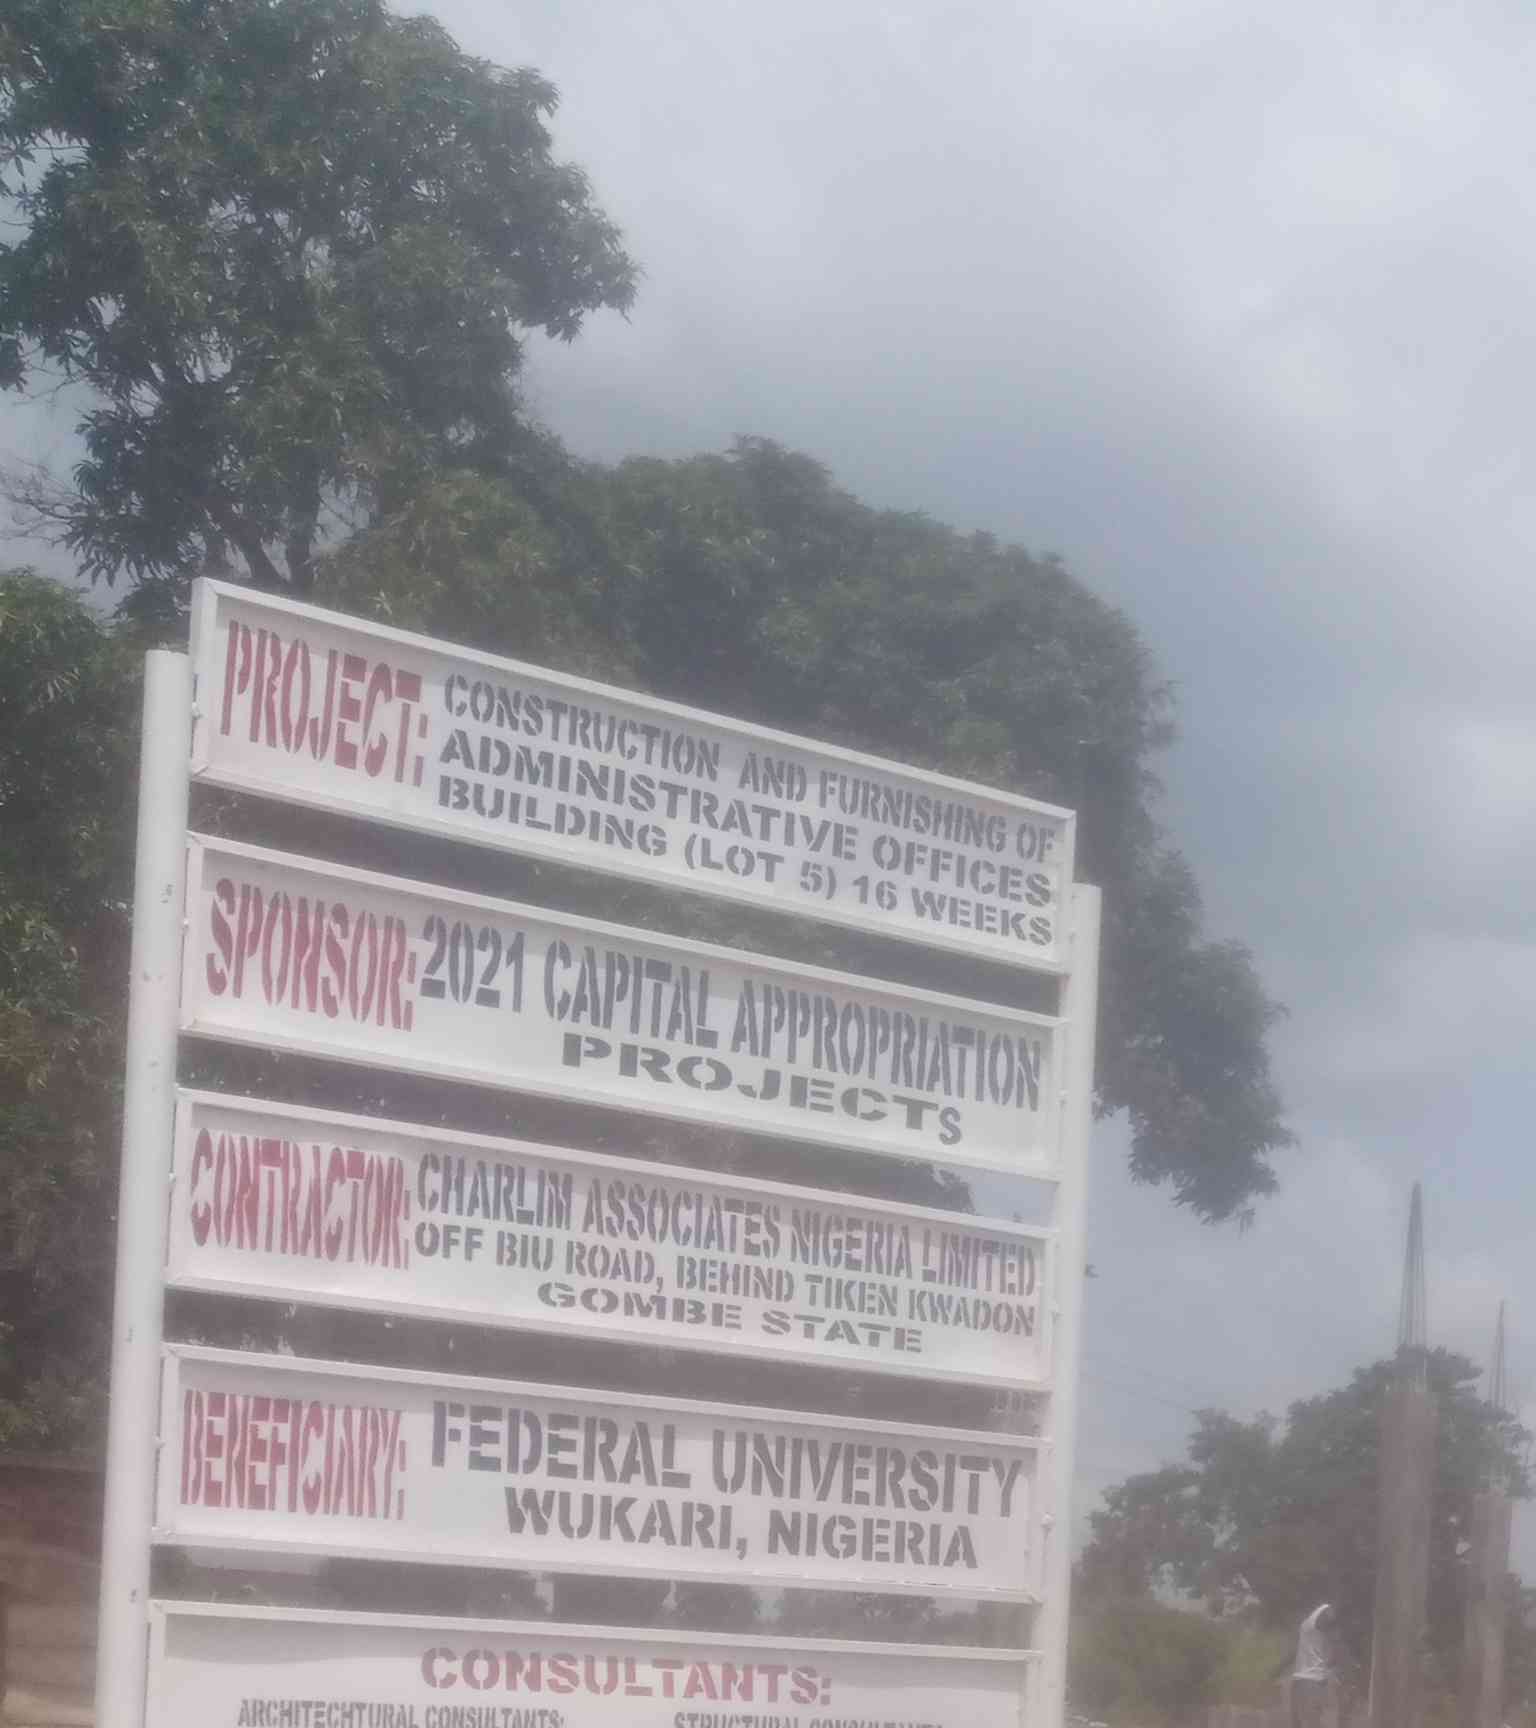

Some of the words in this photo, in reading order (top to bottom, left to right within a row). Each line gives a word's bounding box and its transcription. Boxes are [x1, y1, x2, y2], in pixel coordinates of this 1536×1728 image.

[220, 620, 429, 787] PROJECT:
[444, 673, 720, 782] CONSTRUCTION
[739, 752, 806, 803] AND
[819, 770, 1006, 853] FURNISHING
[1016, 823, 1056, 863] OF
[439, 775, 667, 856] BUILDING
[685, 833, 784, 882] (LOT
[800, 861, 836, 900] 5)
[853, 875, 898, 911] 16
[912, 887, 1052, 946] WEEKS
[440, 729, 858, 860] ADMINISTRATIVE
[873, 834, 1051, 907] OFFICES
[206, 878, 416, 1032] SPONSOR:
[420, 914, 526, 1013] 2021
[544, 939, 719, 1049] CAPITAL
[730, 979, 1040, 1111] APPROPRIATION
[563, 1032, 961, 1145] PROJECTS
[190, 1128, 410, 1270] CONTRACTOR:
[582, 1177, 781, 1259] ASSOCIATES
[790, 1208, 912, 1279] NIGERIA
[922, 1228, 1036, 1297] LIMITED
[415, 1221, 484, 1261] OFF
[496, 1229, 553, 1272] BIU
[566, 1239, 664, 1293] ROAD,
[676, 1255, 794, 1302] BEHIND
[804, 1273, 898, 1317] TIKEN
[908, 1288, 1035, 1337] KWADON
[537, 1282, 742, 1330] GOMBE
[761, 1310, 922, 1353] STATE
[180, 1389, 407, 1521] BENEFICIARY:
[432, 1400, 691, 1489] FEDERAL
[712, 1428, 1022, 1517] UNIVERSITY
[504, 1486, 748, 1560] WUKARI,
[767, 1509, 978, 1569] NIGERIA
[421, 1647, 832, 1706] CONSULTANTS:
